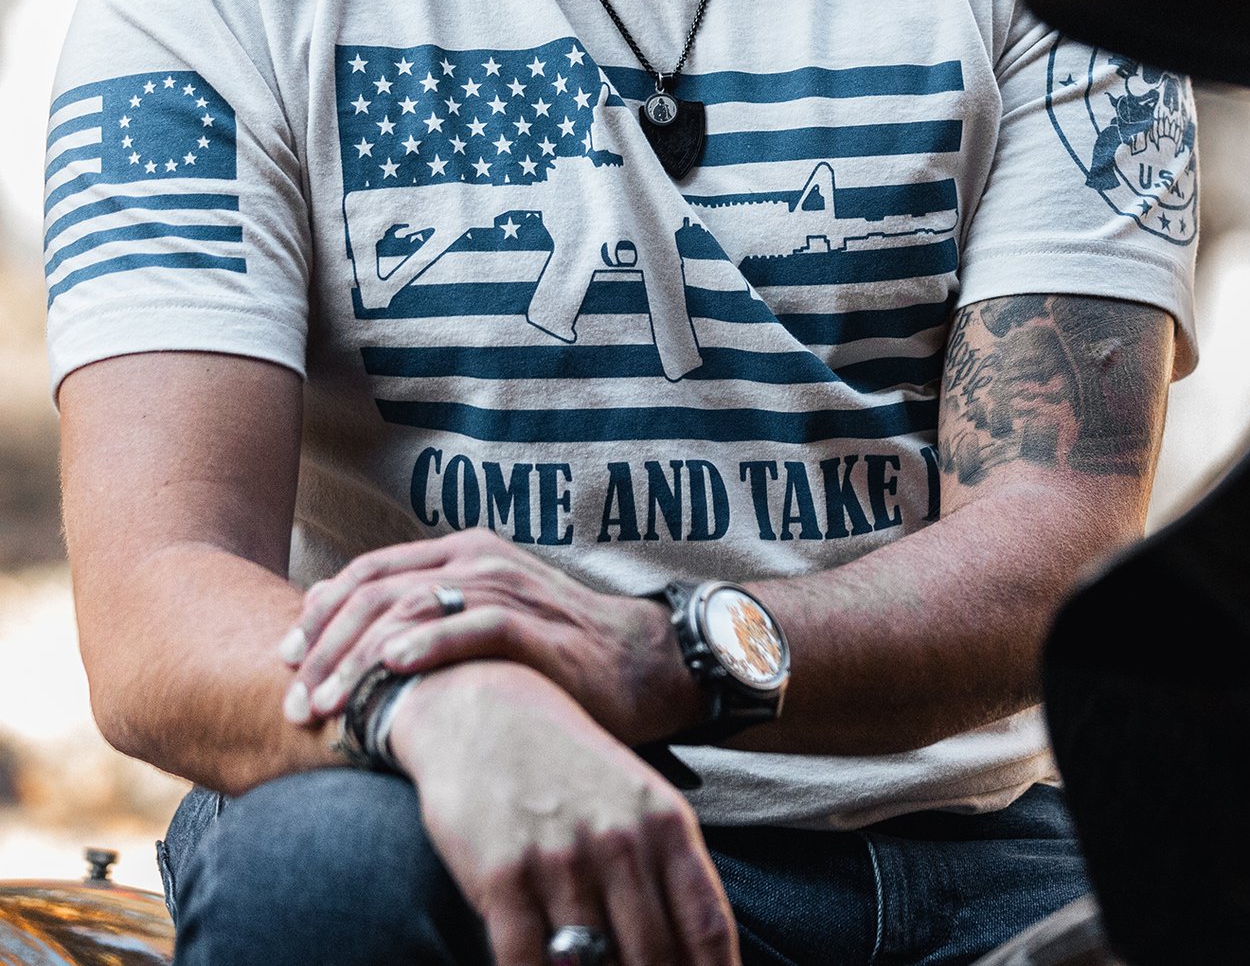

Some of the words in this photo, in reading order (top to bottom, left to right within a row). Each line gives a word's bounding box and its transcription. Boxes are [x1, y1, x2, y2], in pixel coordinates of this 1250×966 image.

[1139, 163, 1184, 199] U.SA.
[410, 447, 574, 545] COME
[597, 460, 730, 542] AND
[739, 454, 902, 541] TAKE
